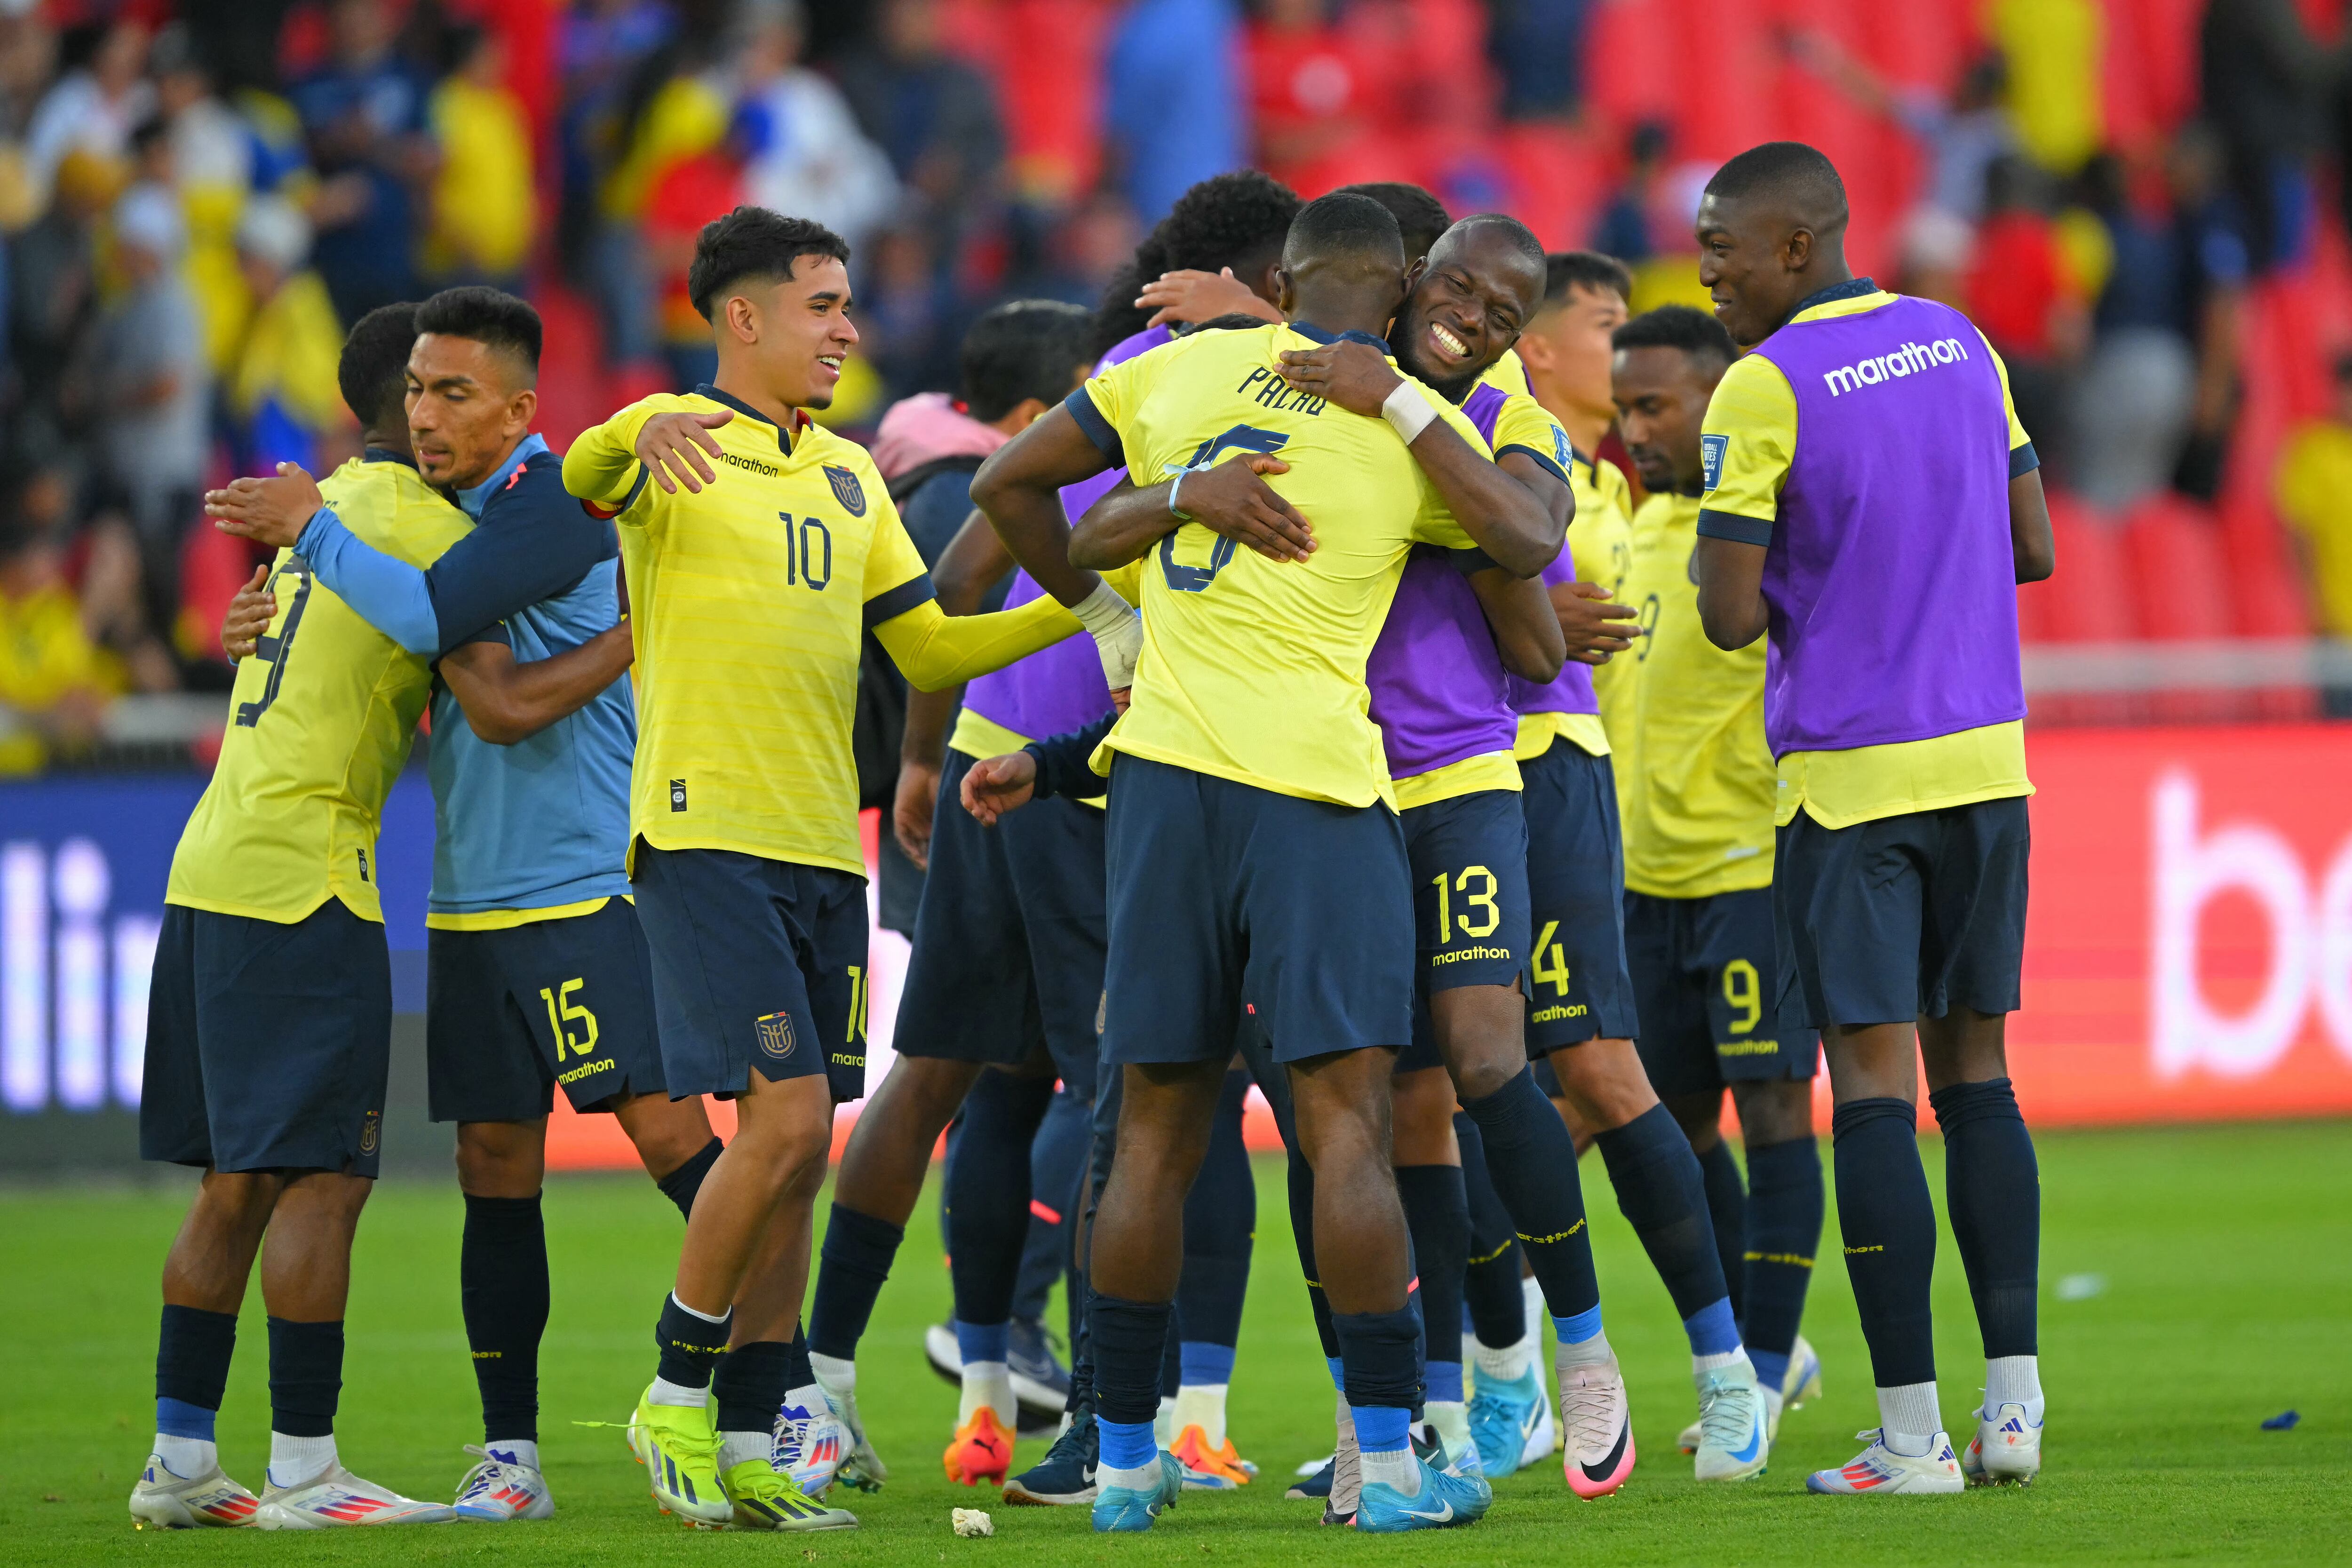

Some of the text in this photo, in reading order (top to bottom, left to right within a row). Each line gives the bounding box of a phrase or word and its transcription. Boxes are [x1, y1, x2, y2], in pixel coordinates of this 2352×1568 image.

[1823, 338, 1969, 397] marathon
[721, 452, 779, 478] marathon
[1159, 423, 1290, 592] 6
[779, 511, 831, 591] 10
[1432, 865, 1500, 944] 13
[1433, 946, 1510, 966] marathon
[540, 977, 599, 1062] 15
[1532, 1003, 1588, 1023] arathon
[1722, 958, 1762, 1034] 9
[558, 1059, 615, 1085] marathon
[1516, 1218, 1586, 1244] arathon
